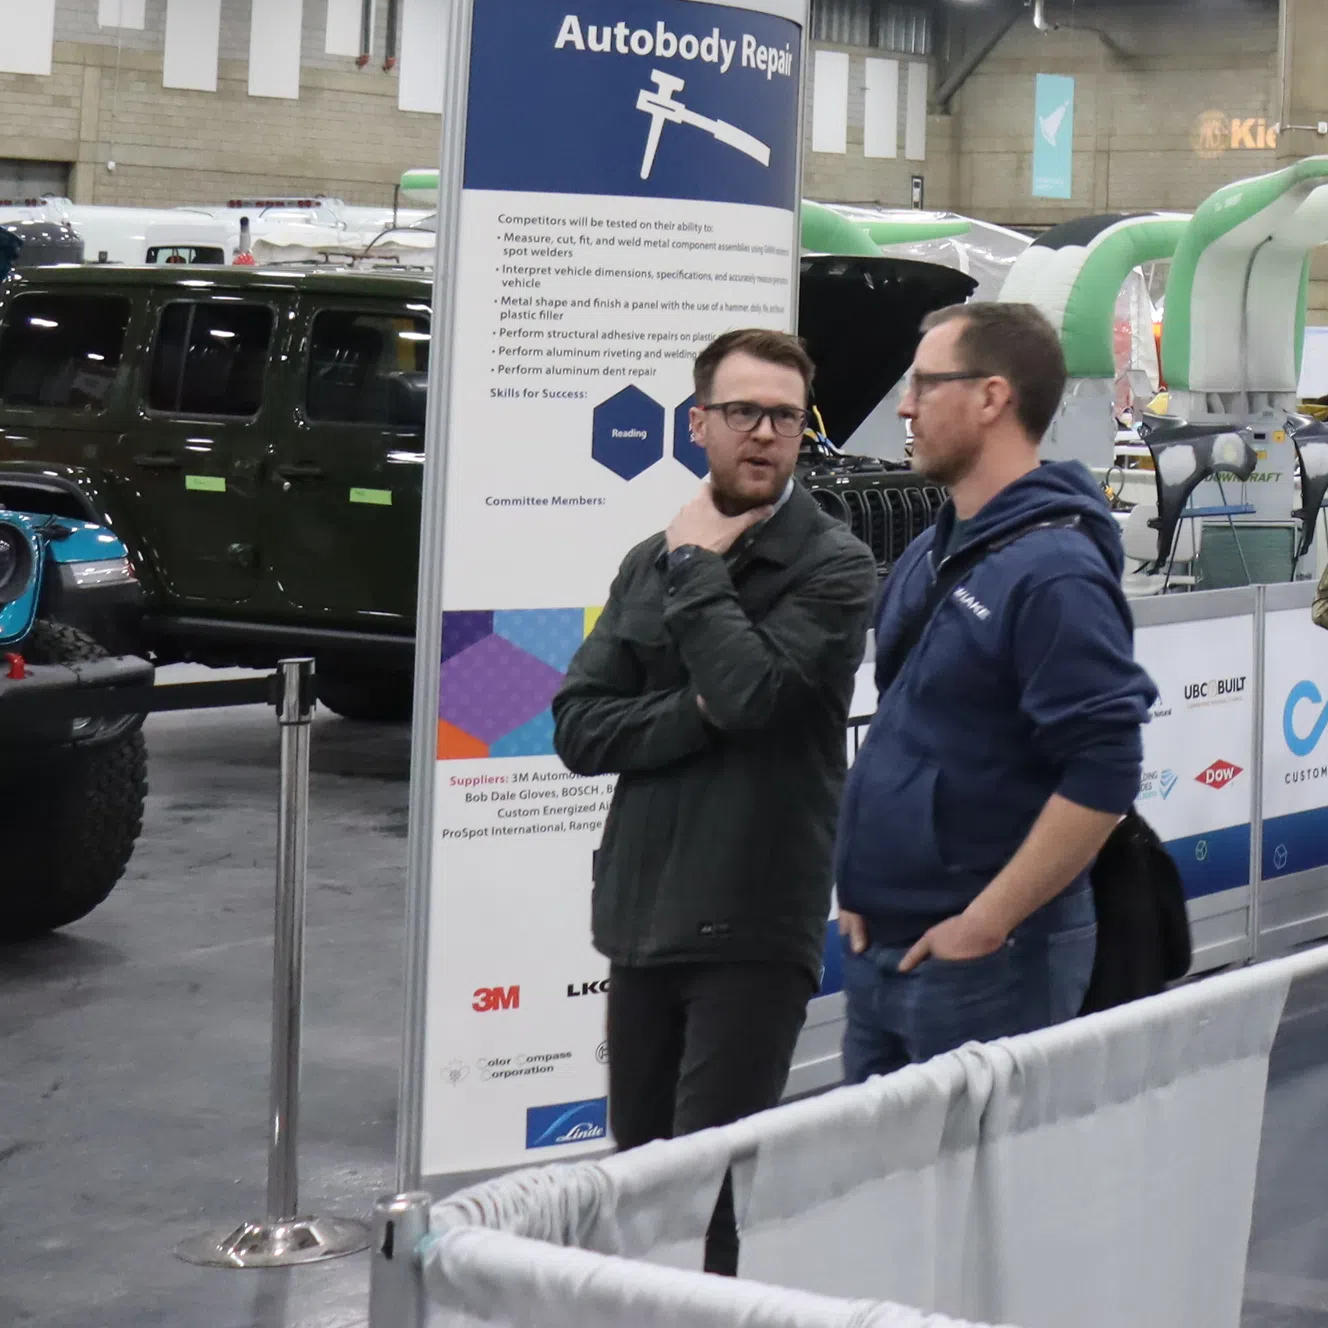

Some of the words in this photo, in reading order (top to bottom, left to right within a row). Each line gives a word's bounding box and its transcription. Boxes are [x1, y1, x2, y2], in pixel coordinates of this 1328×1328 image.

[554, 14, 737, 74] Autobody
[742, 33, 793, 80] Repair
[498, 213, 566, 229] Competitors
[570, 216, 588, 227] will
[591, 216, 603, 228] be
[606, 218, 637, 229] tested
[640, 222, 652, 230] on
[654, 221, 675, 230] their
[677, 222, 702, 235] ability
[503, 232, 554, 245] Measure,
[557, 235, 576, 246] cut,
[579, 234, 593, 246] fit,
[595, 236, 615, 246] and
[618, 236, 641, 247] weld
[644, 238, 670, 248] metal
[672, 240, 717, 251] component
[503, 247, 527, 258] spot
[531, 247, 573, 258] welders
[502, 264, 551, 277] Interpret
[554, 265, 592, 276] vehicle
[595, 267, 654, 279] dimensions,
[656, 270, 713, 282] specifications,
[714, 272, 728, 282] and
[501, 278, 541, 288] vehicle
[500, 296, 532, 306] Metal
[535, 296, 568, 309] shape
[570, 298, 591, 308] and
[593, 298, 621, 309] finish
[632, 300, 659, 311] panel
[660, 300, 680, 310] with
[682, 301, 695, 311] the
[711, 301, 719, 311] of
[500, 310, 536, 321] plastic
[539, 310, 564, 320] filler
[499, 328, 544, 338] Perform
[547, 329, 598, 340] structural
[601, 330, 645, 340] adhesive
[647, 331, 678, 343] repairs
[692, 331, 716, 343] plastic
[498, 346, 543, 356] Perform
[546, 347, 600, 358] aluminum
[603, 348, 642, 360] riveting
[644, 349, 661, 359] and
[664, 349, 697, 360] welding
[498, 364, 543, 375] Perform
[545, 365, 600, 376] aluminum
[602, 366, 626, 376] dent
[628, 367, 656, 378] repair
[490, 388, 520, 398] Skills
[523, 388, 539, 398] for
[542, 389, 587, 399] Success:
[611, 428, 647, 440] Reading
[485, 496, 549, 506] Committee
[551, 496, 606, 506] Members:
[1184, 682, 1208, 700] UBC
[1217, 676, 1246, 694] BUILT
[1154, 708, 1172, 719] Natural
[450, 775, 509, 788] Suppliers:
[511, 773, 529, 783] 3M
[1284, 766, 1328, 784] CUSTOM
[465, 792, 487, 803] Bob
[491, 791, 516, 802] Dale
[519, 788, 559, 800] Gloves,
[562, 785, 599, 798] BOSCH
[497, 808, 540, 819] Custom
[543, 802, 596, 816] Energized
[442, 828, 488, 840] ProSpot
[491, 822, 567, 836] International,
[569, 821, 603, 833] Range
[472, 985, 520, 1012] 3M
[476, 1058, 512, 1070] Color
[516, 1051, 572, 1066] Compass
[480, 1065, 554, 1082] Corporation
[556, 1122, 604, 1142] Linde
